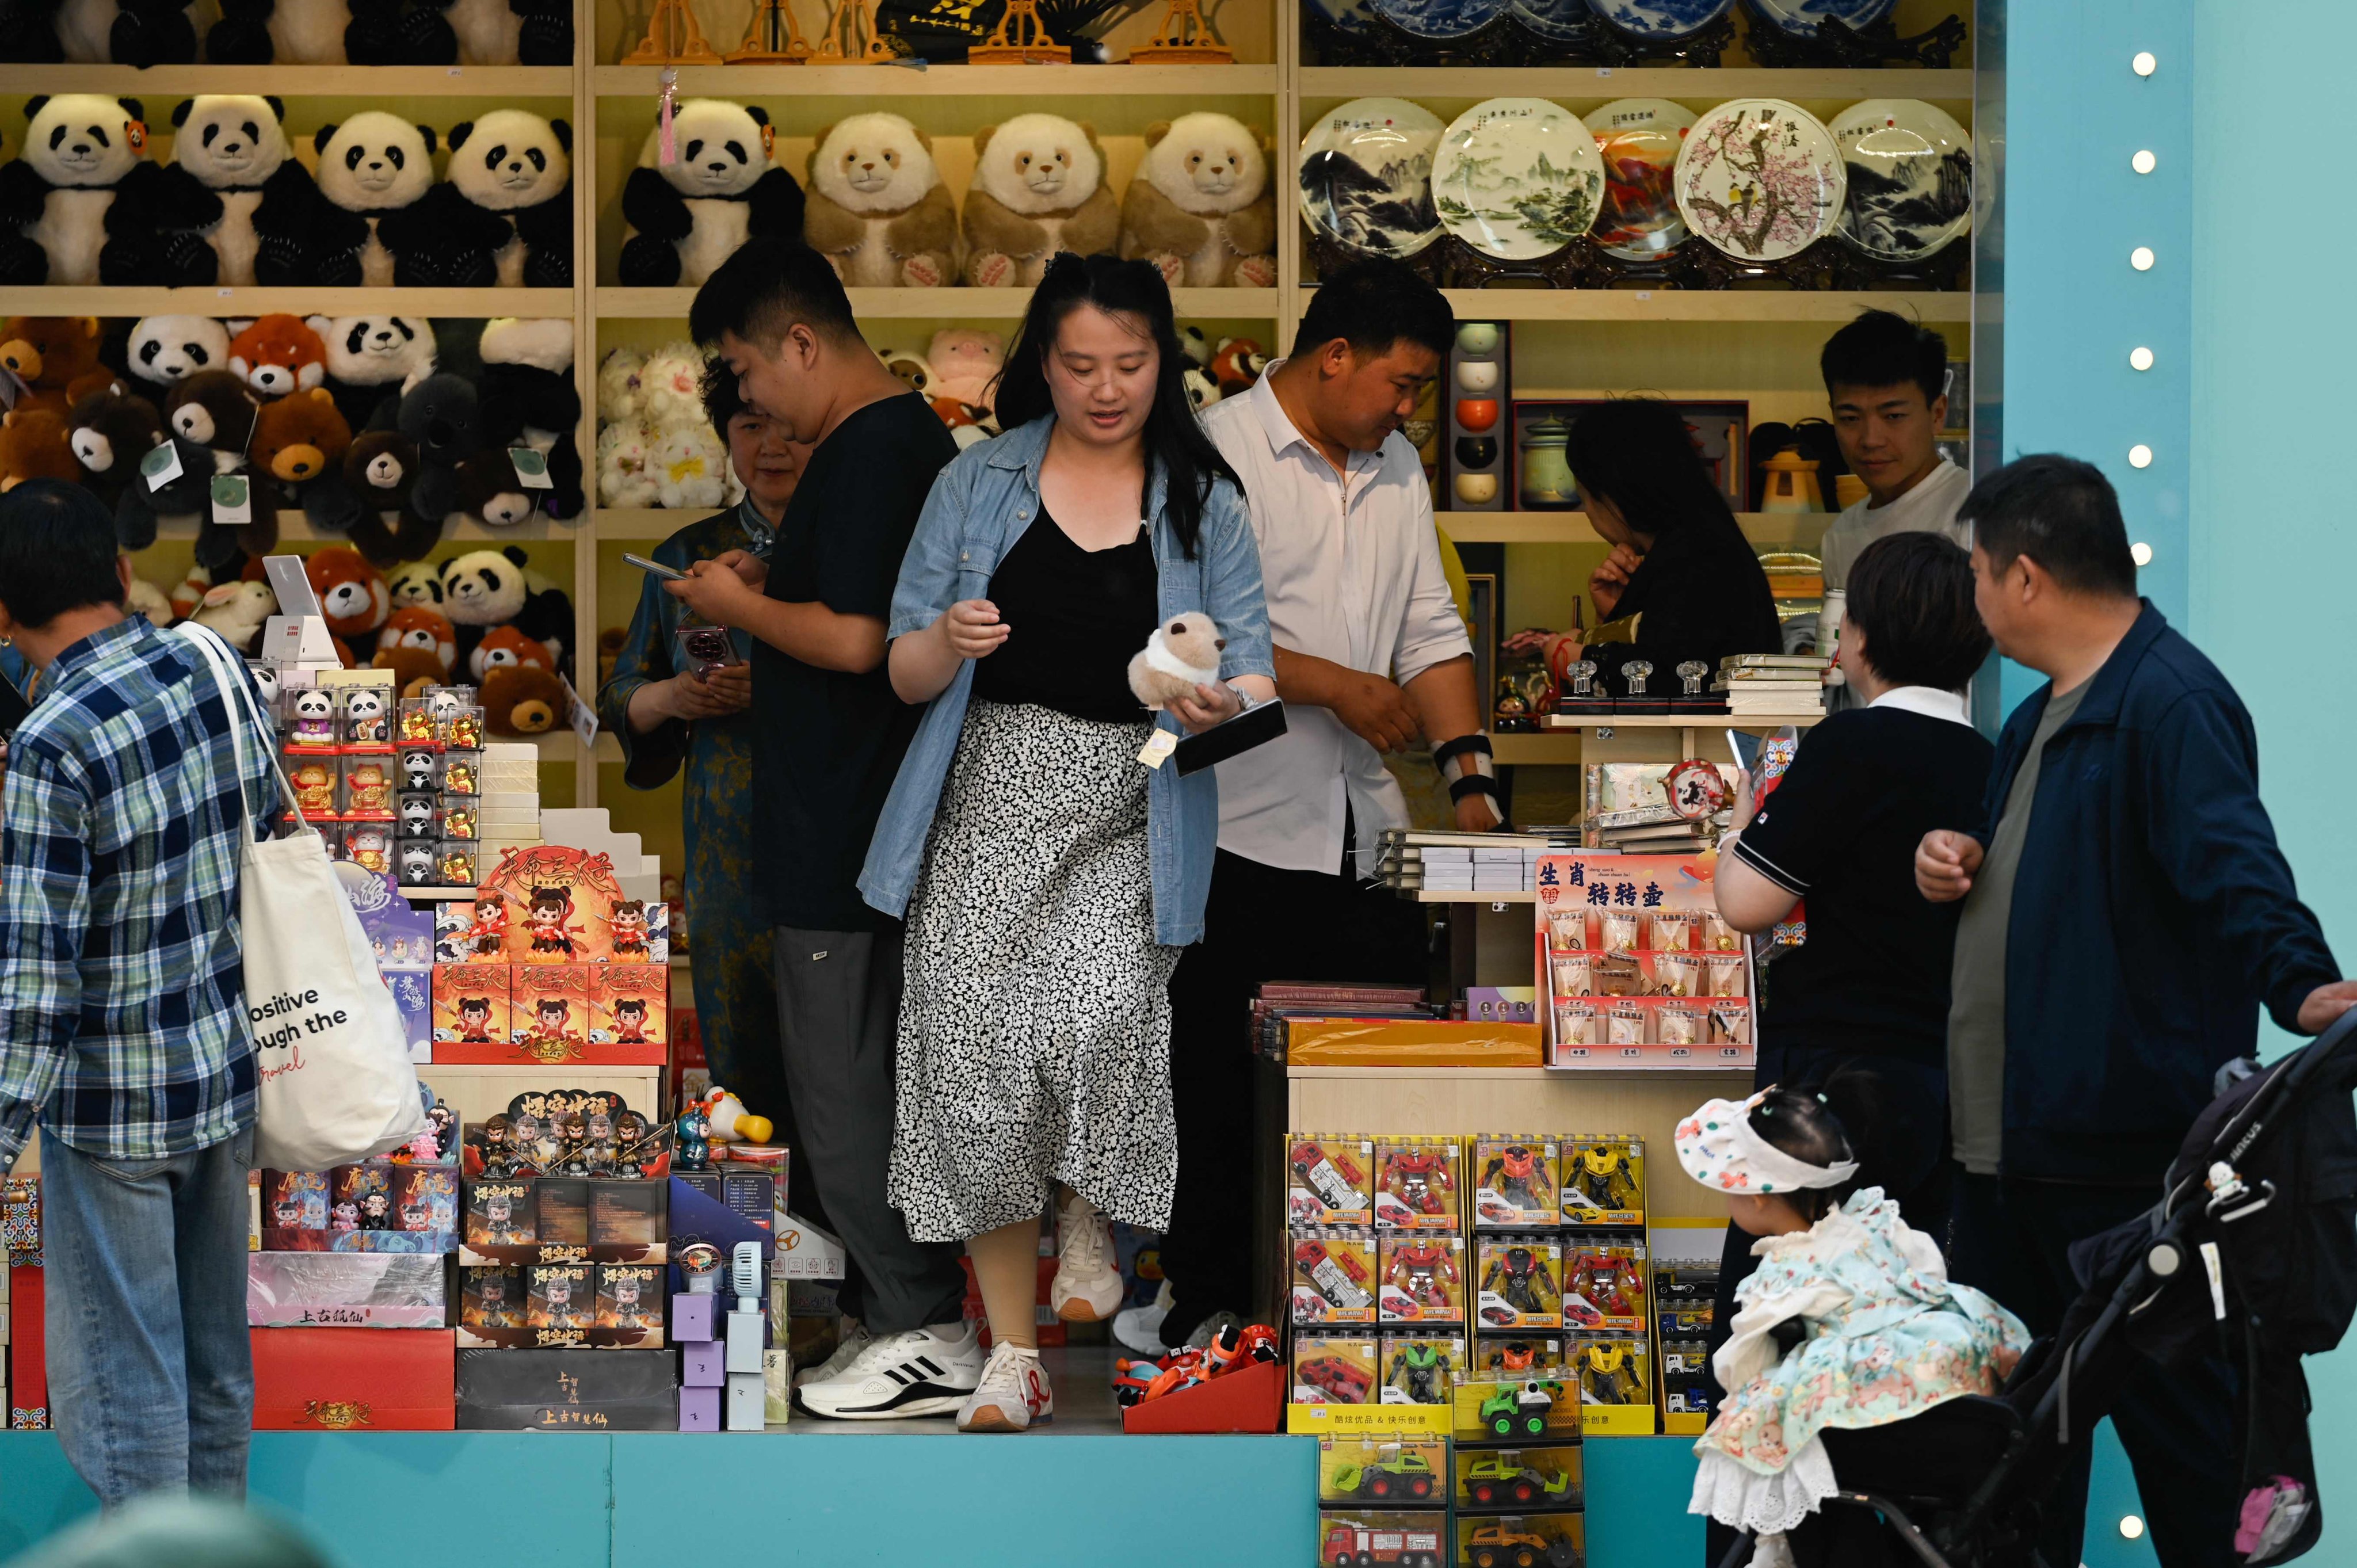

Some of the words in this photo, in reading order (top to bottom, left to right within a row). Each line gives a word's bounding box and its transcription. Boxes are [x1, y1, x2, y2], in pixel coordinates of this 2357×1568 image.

[478, 847, 617, 892] 天命三太子
[1539, 861, 1585, 887] 生肖
[1587, 882, 1664, 907] 转转壶
[434, 966, 511, 991] 天命三太子
[513, 966, 589, 993] 天命三太子
[590, 966, 666, 993] 天命三太子
[250, 990, 319, 1022] ositive
[305, 1010, 348, 1033] the
[300, 1309, 364, 1323] 上古狐仙
[293, 1400, 375, 1425] 天命三太子
[541, 1409, 608, 1429] 上古智慧仙
[1334, 1415, 1373, 1424] 酷炫优品
[1388, 1415, 1427, 1424] 快乐创意
[1582, 1416, 1610, 1425] 乐创意
